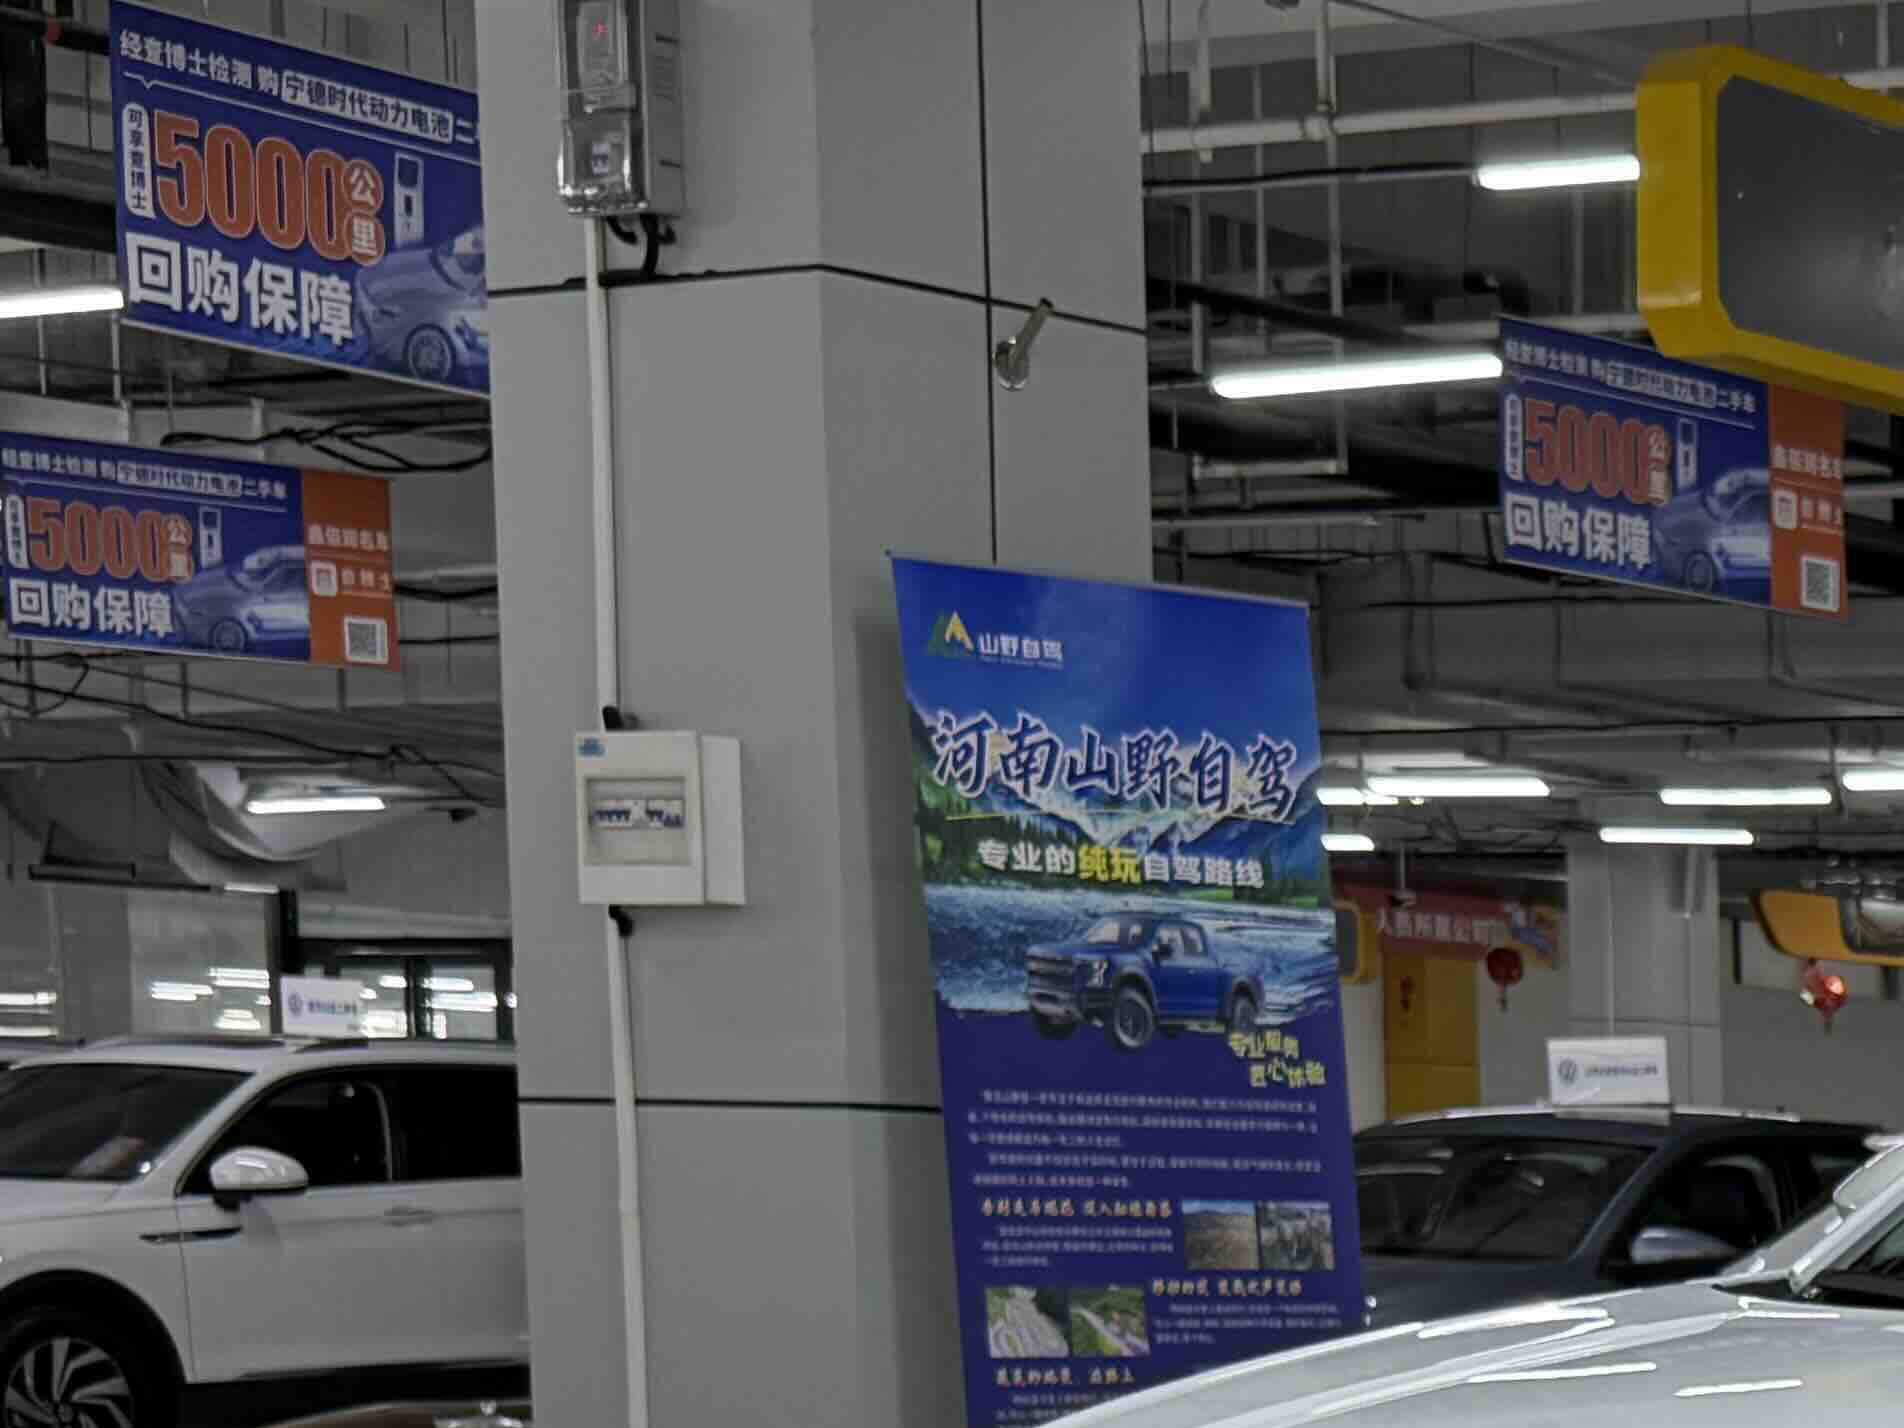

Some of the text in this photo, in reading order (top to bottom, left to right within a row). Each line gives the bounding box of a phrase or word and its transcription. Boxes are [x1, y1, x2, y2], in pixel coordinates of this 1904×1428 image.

[155, 111, 348, 260] 5000
[350, 166, 378, 256] 公里
[125, 232, 353, 344] 回购保障
[1525, 399, 1650, 503] 5000
[27, 496, 168, 583] 5000
[1505, 491, 1651, 569] 回购保障
[9, 577, 174, 638] 回购保障
[932, 710, 1297, 821] 河南山野自驾
[978, 839, 1264, 888] 专业的纯玩自驾路线
